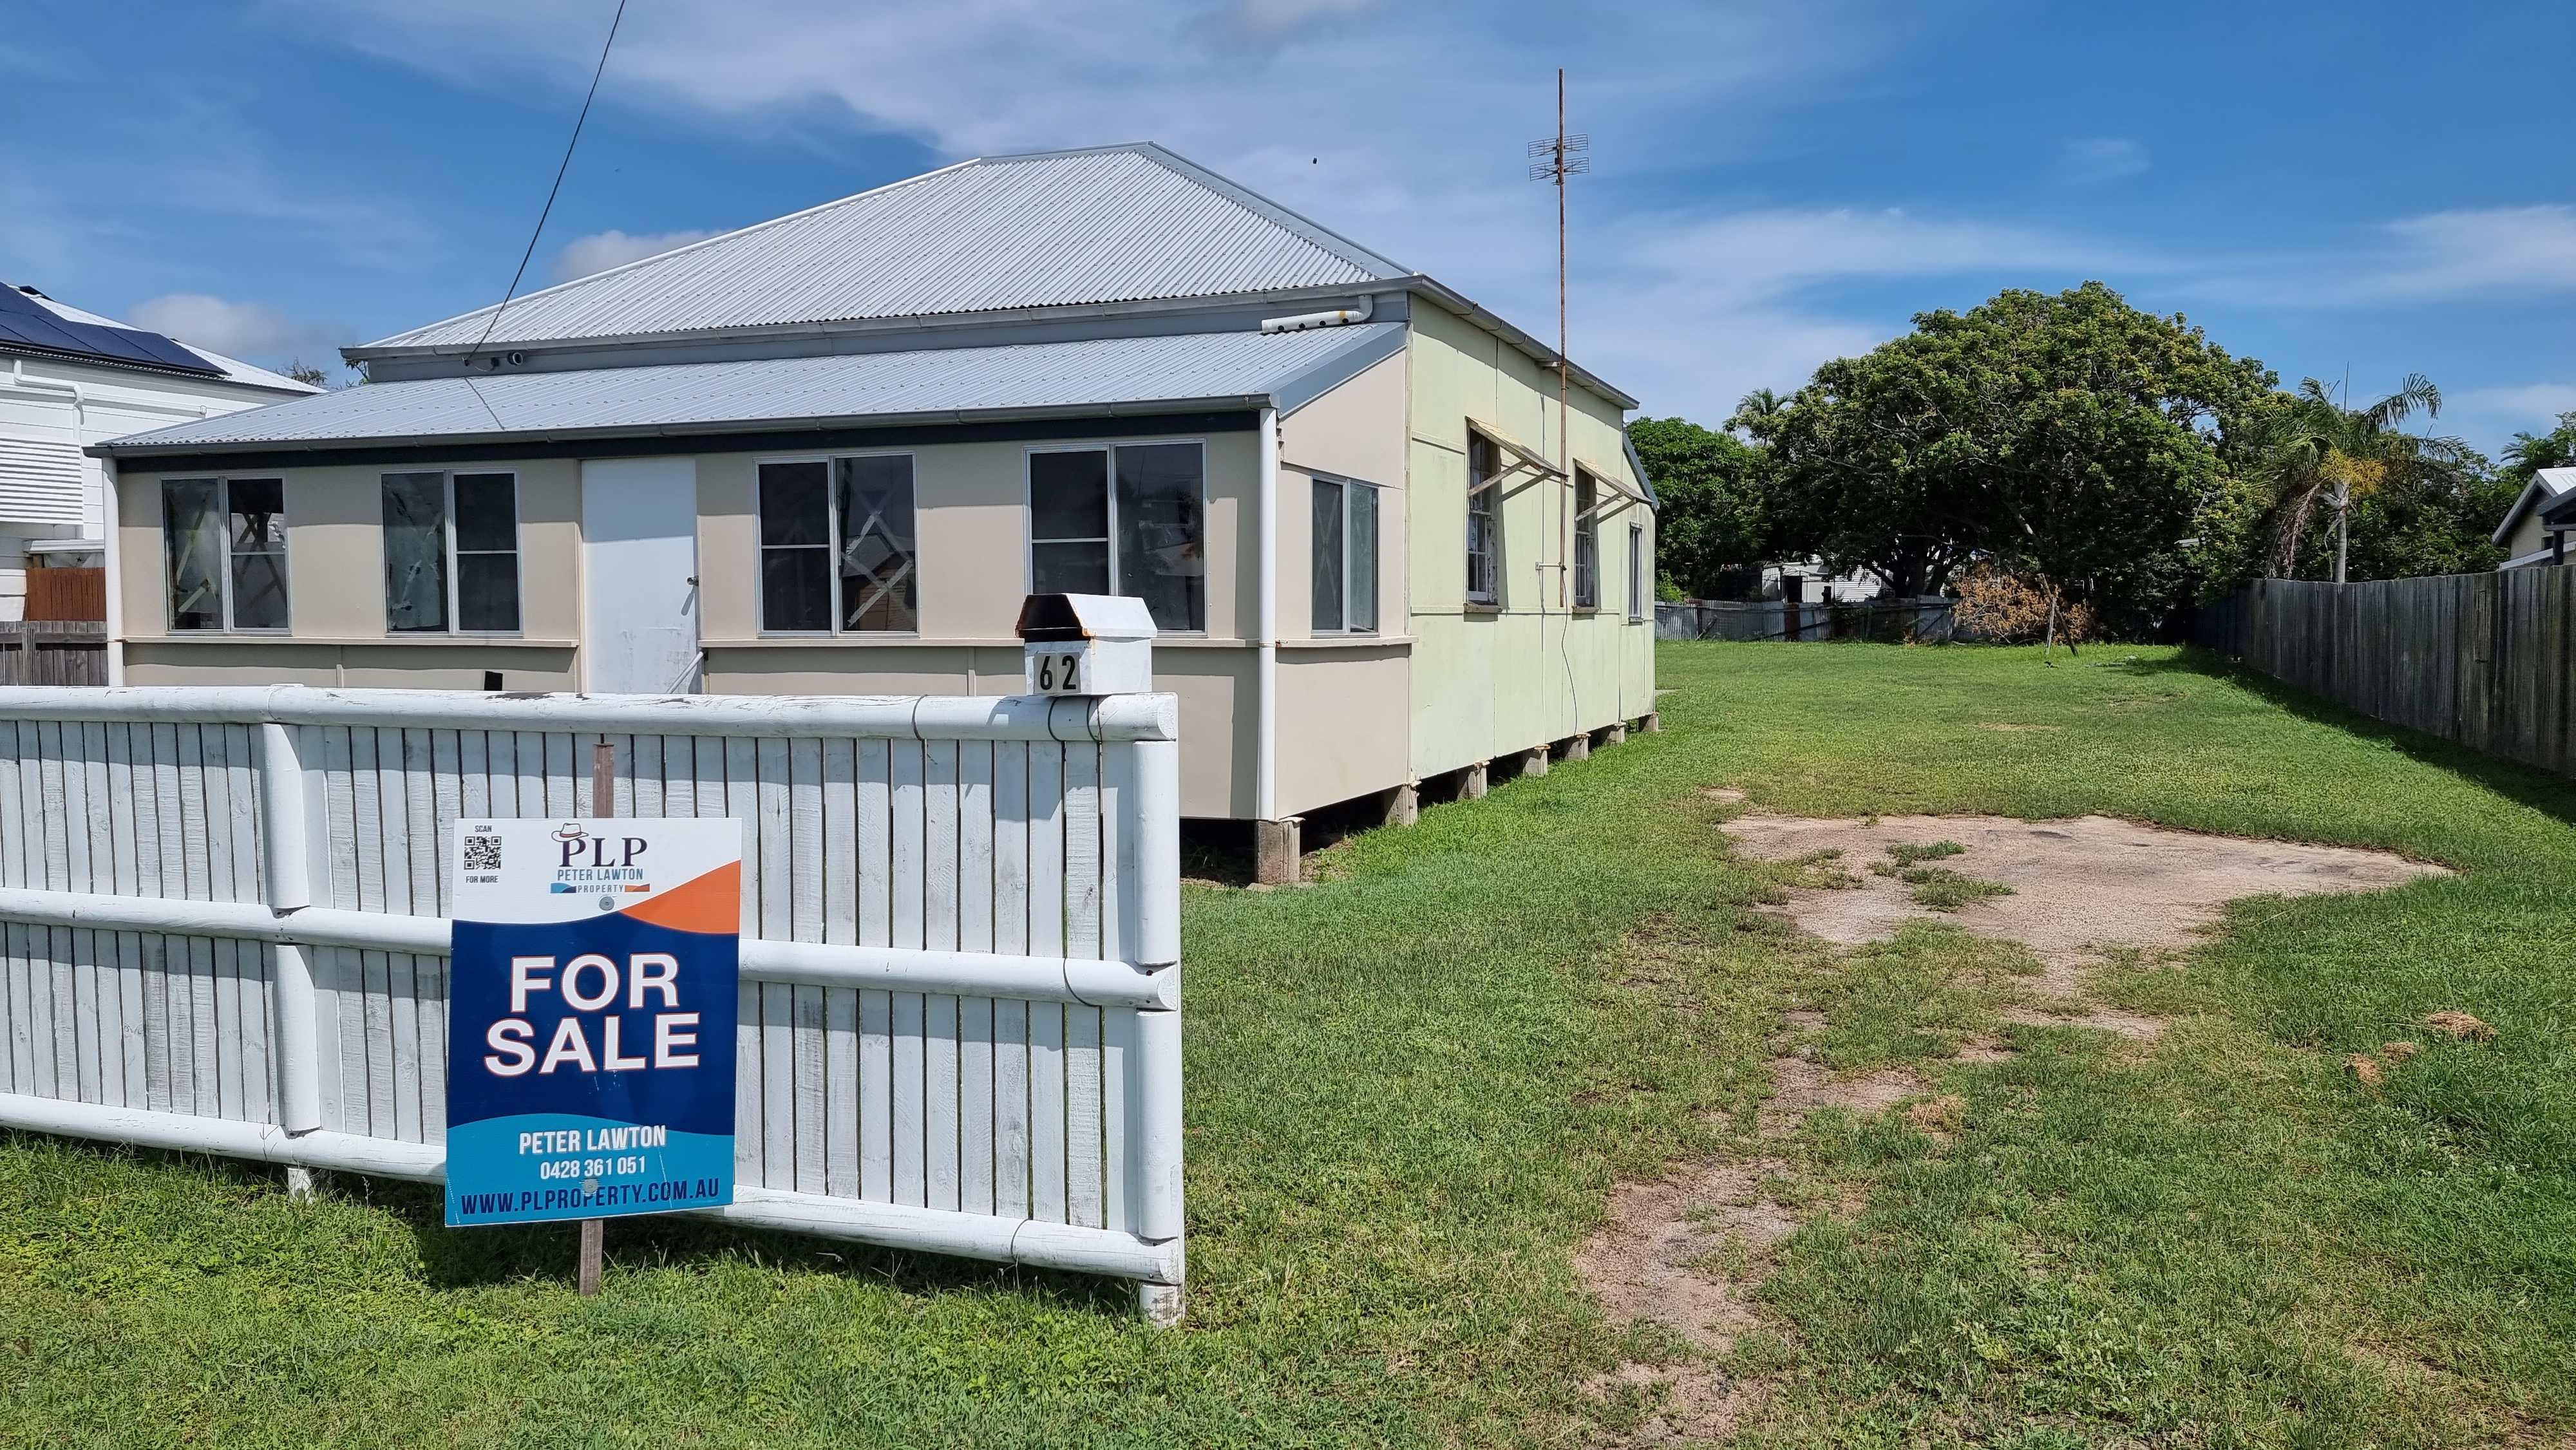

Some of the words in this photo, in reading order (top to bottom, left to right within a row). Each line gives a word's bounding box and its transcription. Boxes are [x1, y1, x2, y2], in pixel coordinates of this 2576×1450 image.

[1040, 655, 1076, 690] 62
[558, 837, 648, 867] PLP
[480, 875, 498, 883] MORE
[557, 869, 593, 881] PETER
[597, 868, 643, 881] LAWTON
[578, 885, 624, 893] PROPERTY
[511, 953, 679, 1013] FOR
[484, 1012, 700, 1077] SALE
[519, 1129, 580, 1154] PETER
[587, 1125, 666, 1151] LAWTON
[540, 1160, 580, 1180] 0428
[584, 1158, 612, 1177] 361
[616, 1156, 646, 1174] 051
